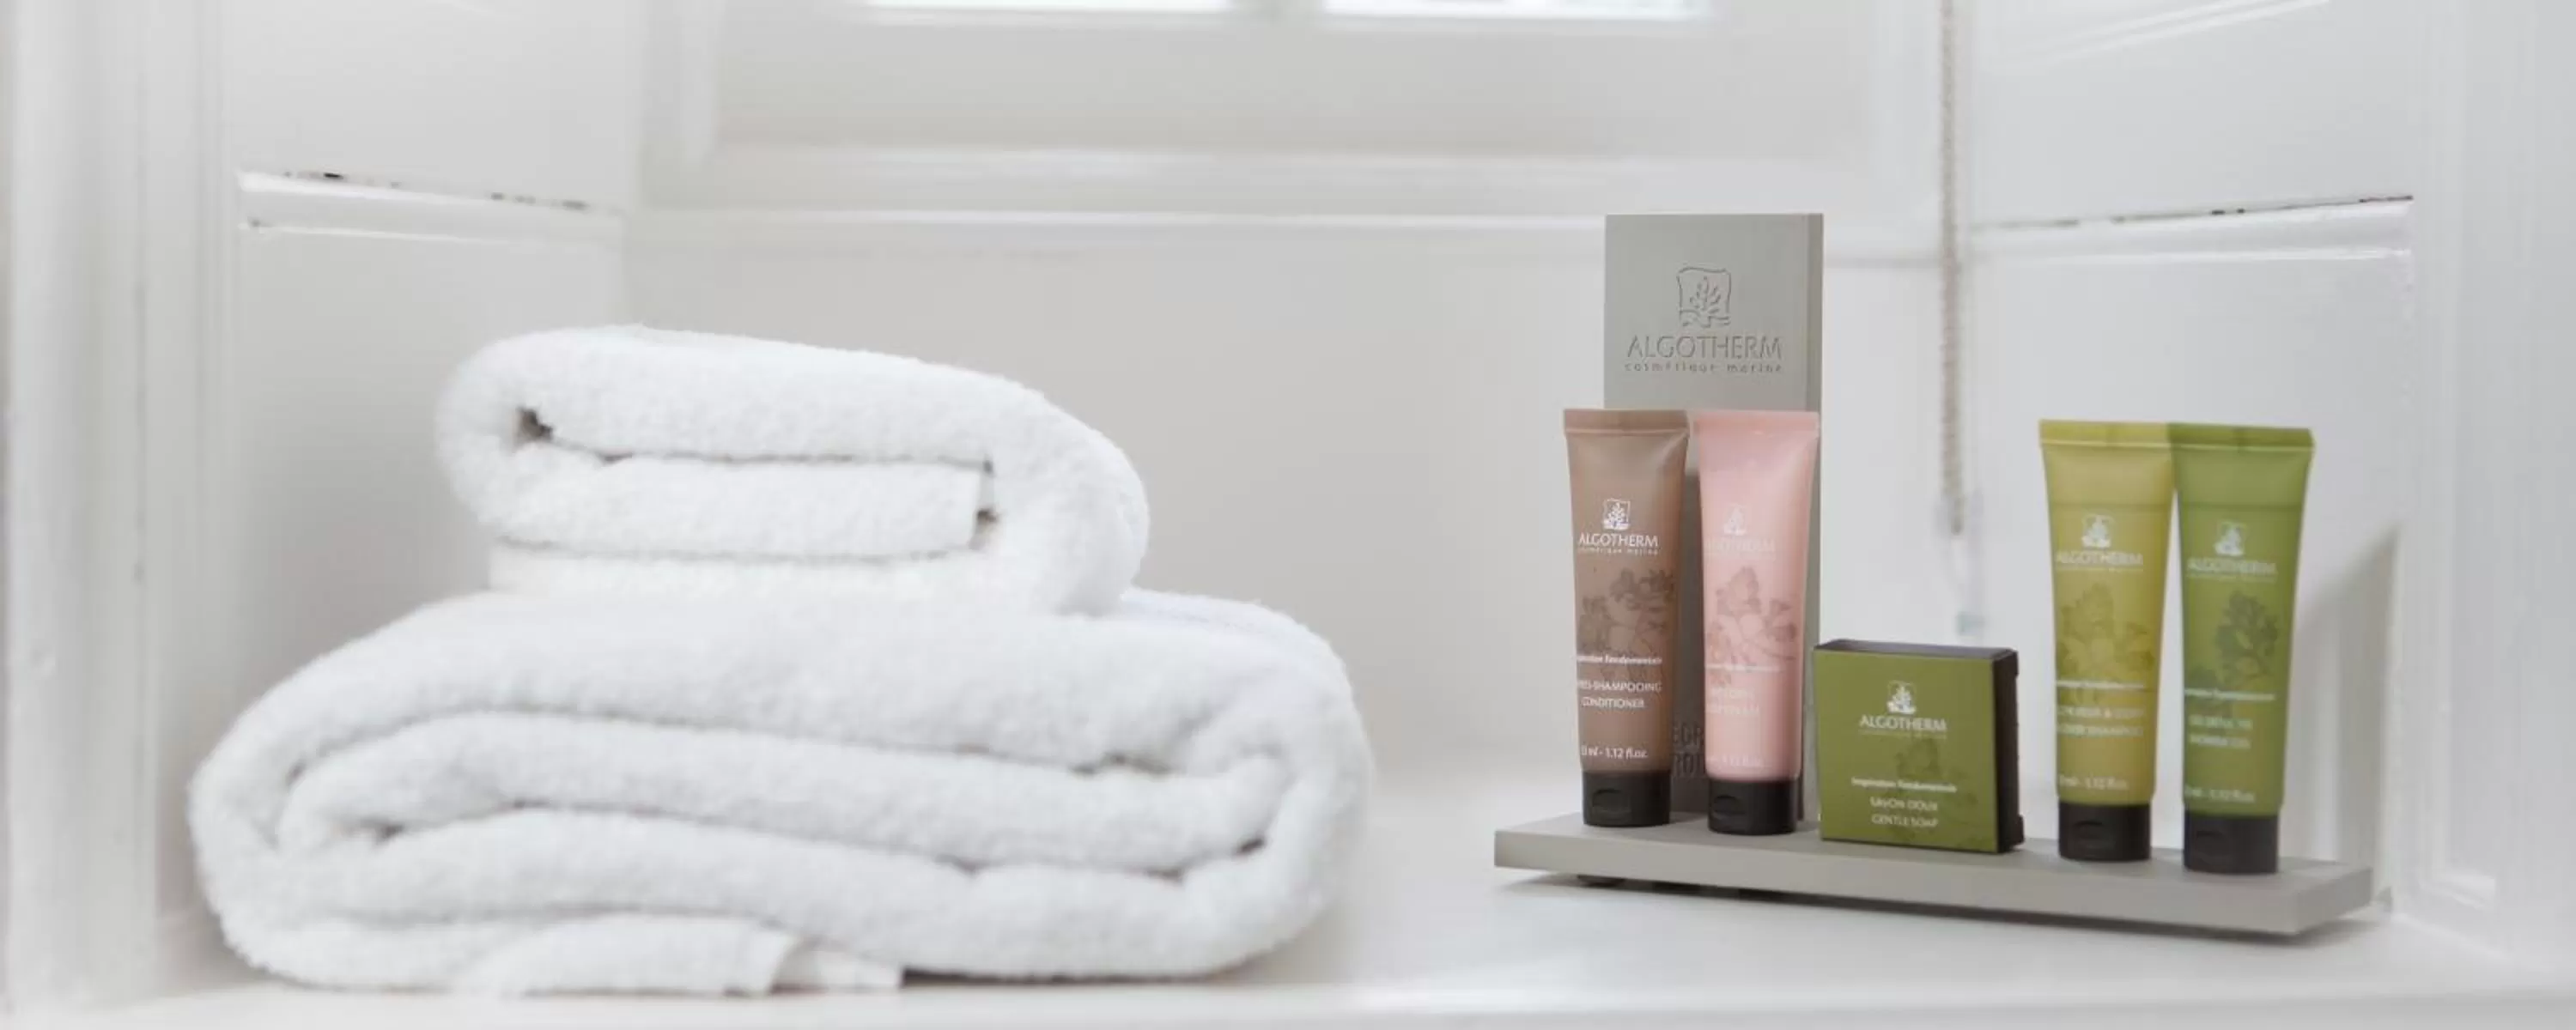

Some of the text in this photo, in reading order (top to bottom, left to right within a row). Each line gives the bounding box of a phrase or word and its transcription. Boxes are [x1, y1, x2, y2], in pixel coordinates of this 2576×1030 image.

[1626, 335, 1783, 360] ALGOTHERM
[1578, 531, 1659, 547] ALGOTHERM
[1581, 695, 1646, 710] CONDITIONER
[1859, 714, 1947, 731] ALGOTHERM
[1605, 747, 1624, 760] 1.12
